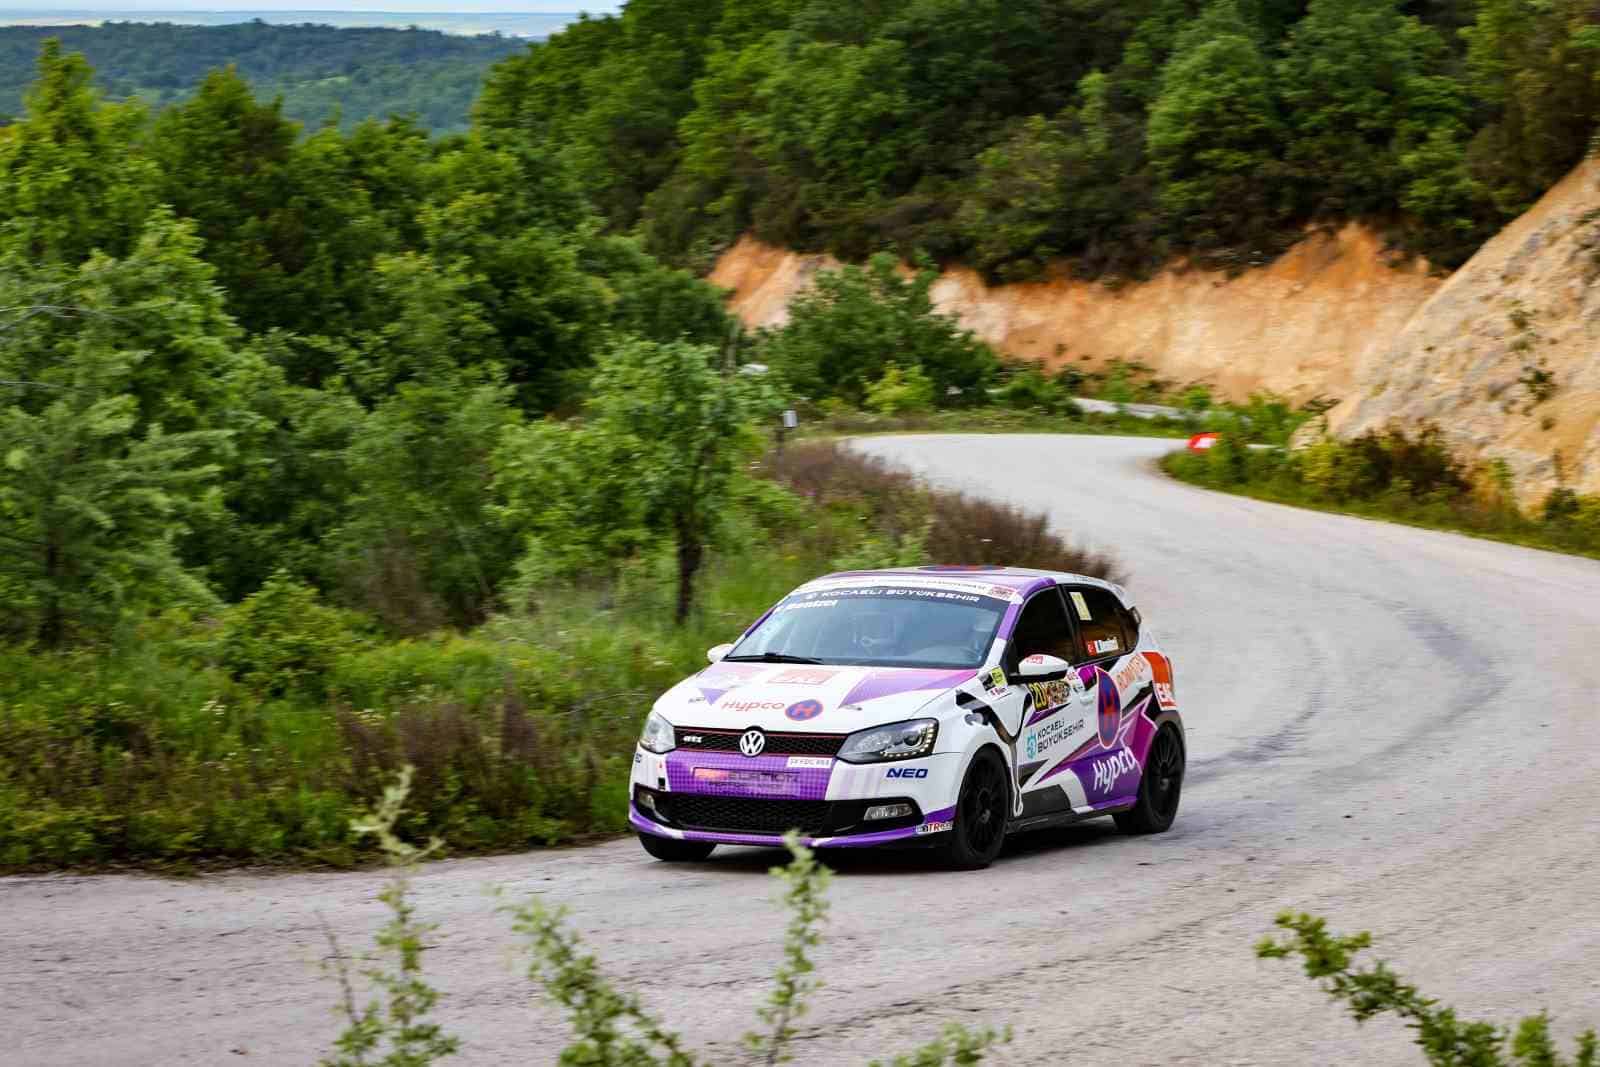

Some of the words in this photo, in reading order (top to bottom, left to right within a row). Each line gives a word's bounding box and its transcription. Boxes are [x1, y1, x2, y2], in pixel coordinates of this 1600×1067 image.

[721, 701, 785, 711] Hypco
[886, 768, 928, 778] NEO
[1092, 746, 1136, 794] Hypco
